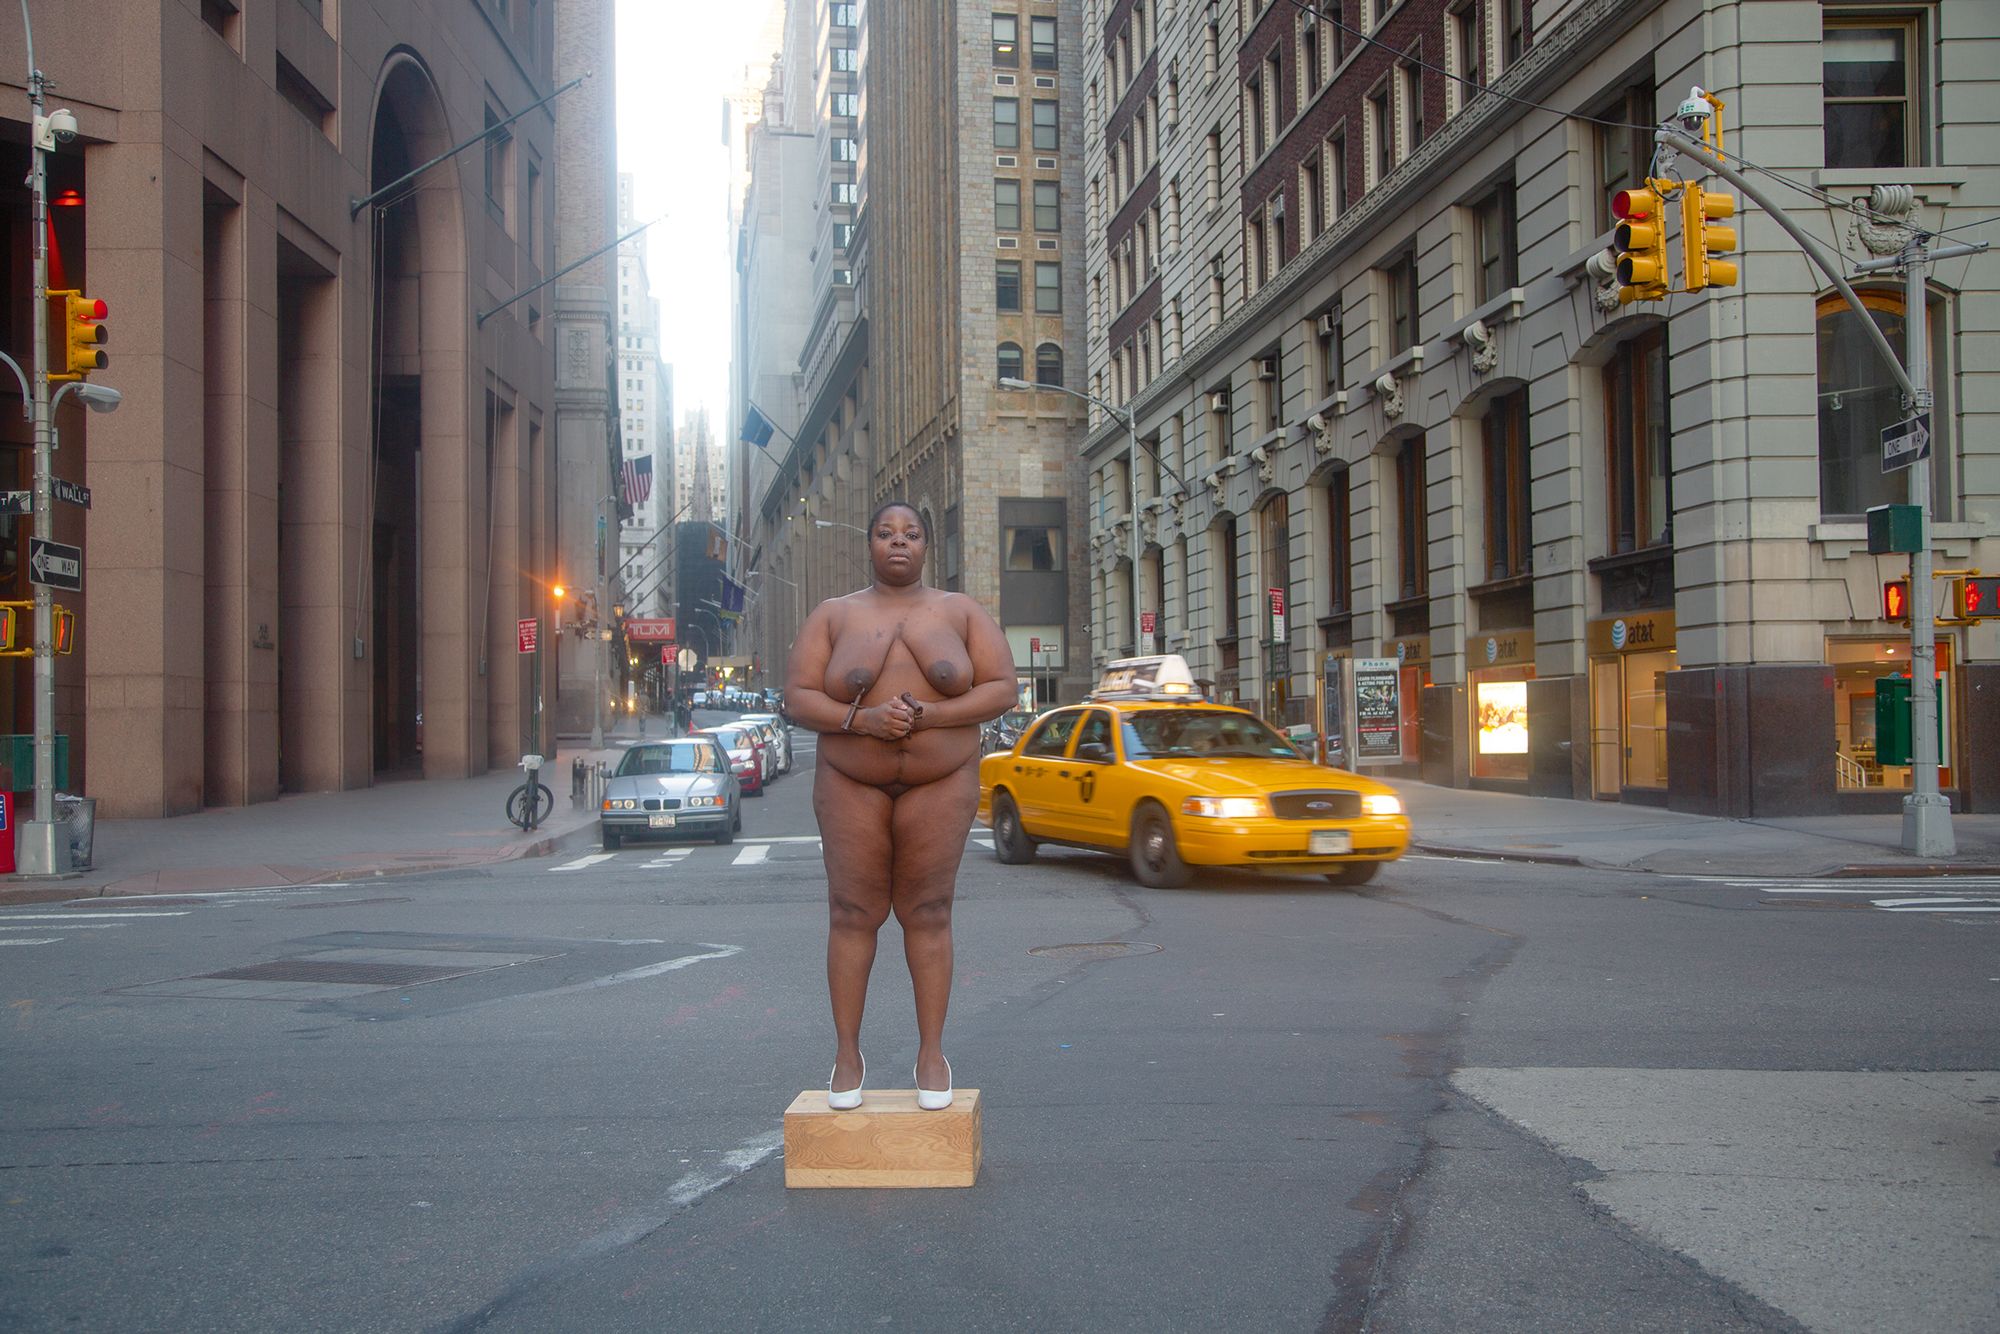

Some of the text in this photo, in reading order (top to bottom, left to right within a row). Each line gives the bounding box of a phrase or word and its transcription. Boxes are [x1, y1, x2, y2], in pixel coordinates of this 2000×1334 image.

[1887, 430, 1925, 456] ONE WAY
[61, 485, 84, 504] WALL
[37, 555, 76, 574] ONE WAY
[629, 623, 670, 636] TUMI
[1628, 619, 1655, 644] at&t
[1405, 641, 1421, 660] at&t
[1498, 637, 1518, 658] at&t
